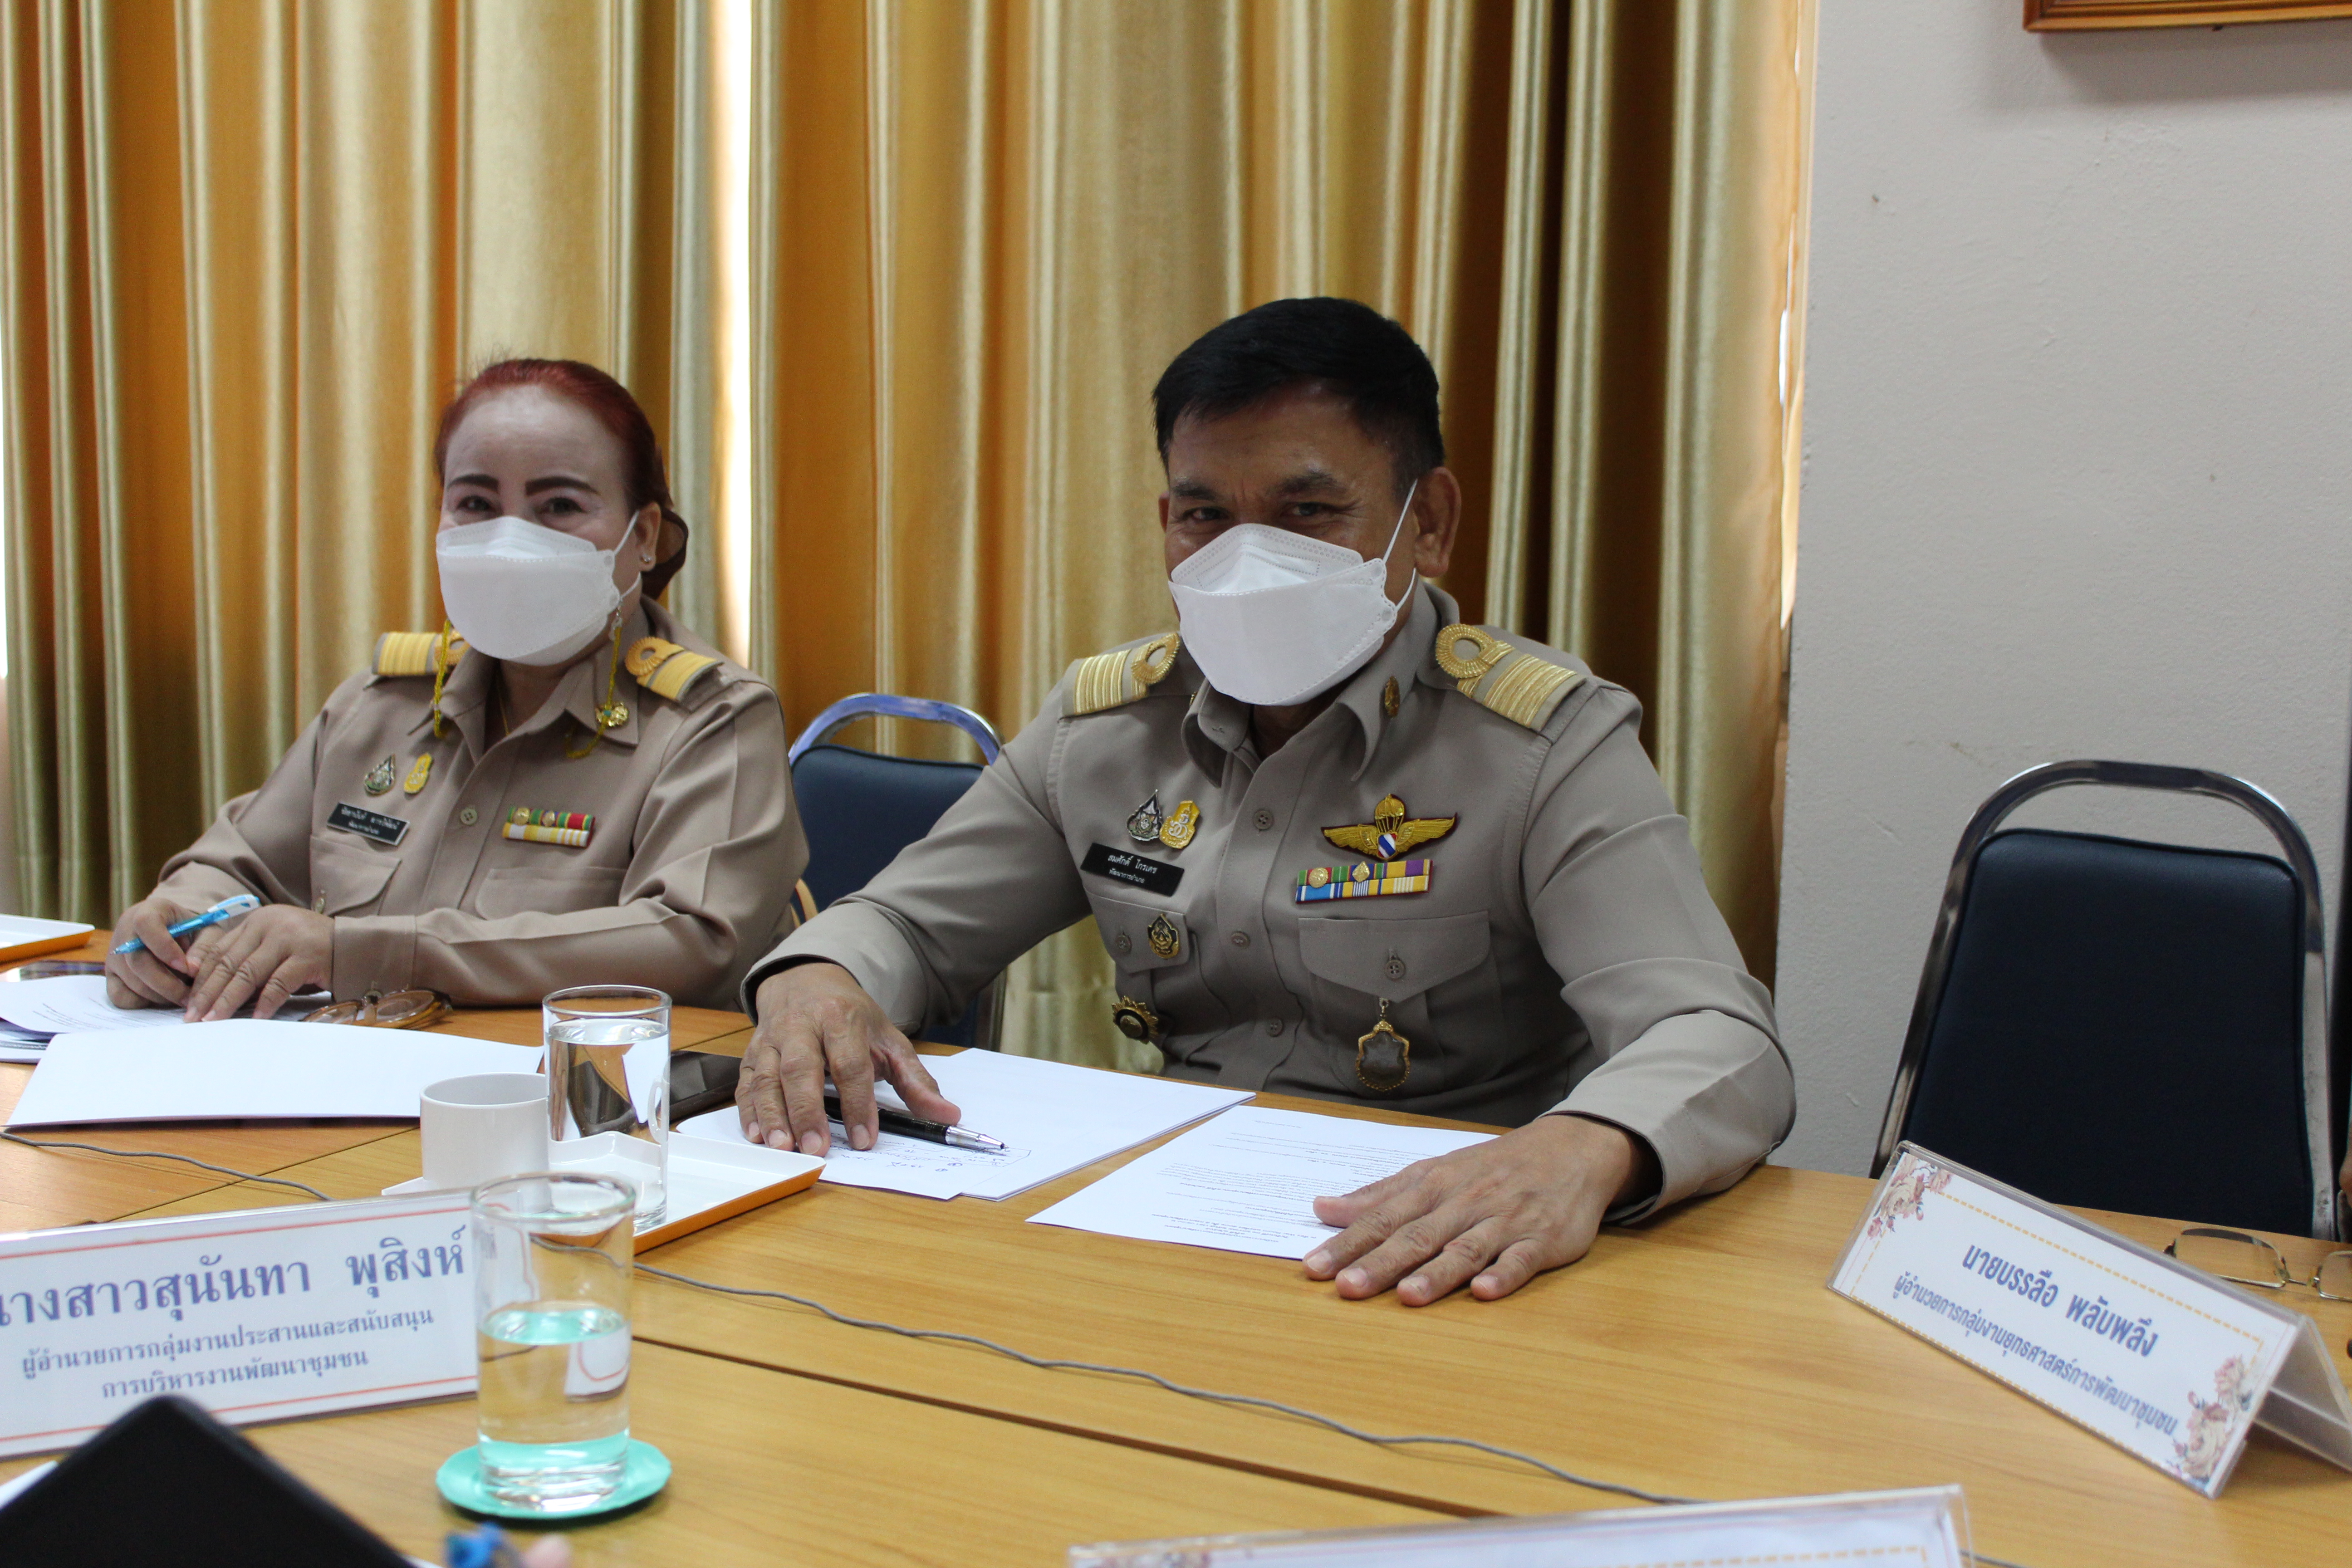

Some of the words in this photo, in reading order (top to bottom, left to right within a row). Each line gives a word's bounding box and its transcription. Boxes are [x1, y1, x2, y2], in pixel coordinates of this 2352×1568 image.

[346, 1225, 466, 1298] พุสิงห์
[1962, 1245, 2058, 1308] นายบรรลือ
[2065, 1294, 2159, 1357] พลับพลึง
[23, 1309, 434, 1379] ผู้อำนวยการกลุ่มงานประสานและสนับสนุน
[103, 1350, 369, 1397] การบริหารงานพัฒนาชุมชน
[1893, 1271, 2178, 1436] ผู้อำนวยการกลุ่มงานยุทธศาสตร์การพัฒนาชุมชน
